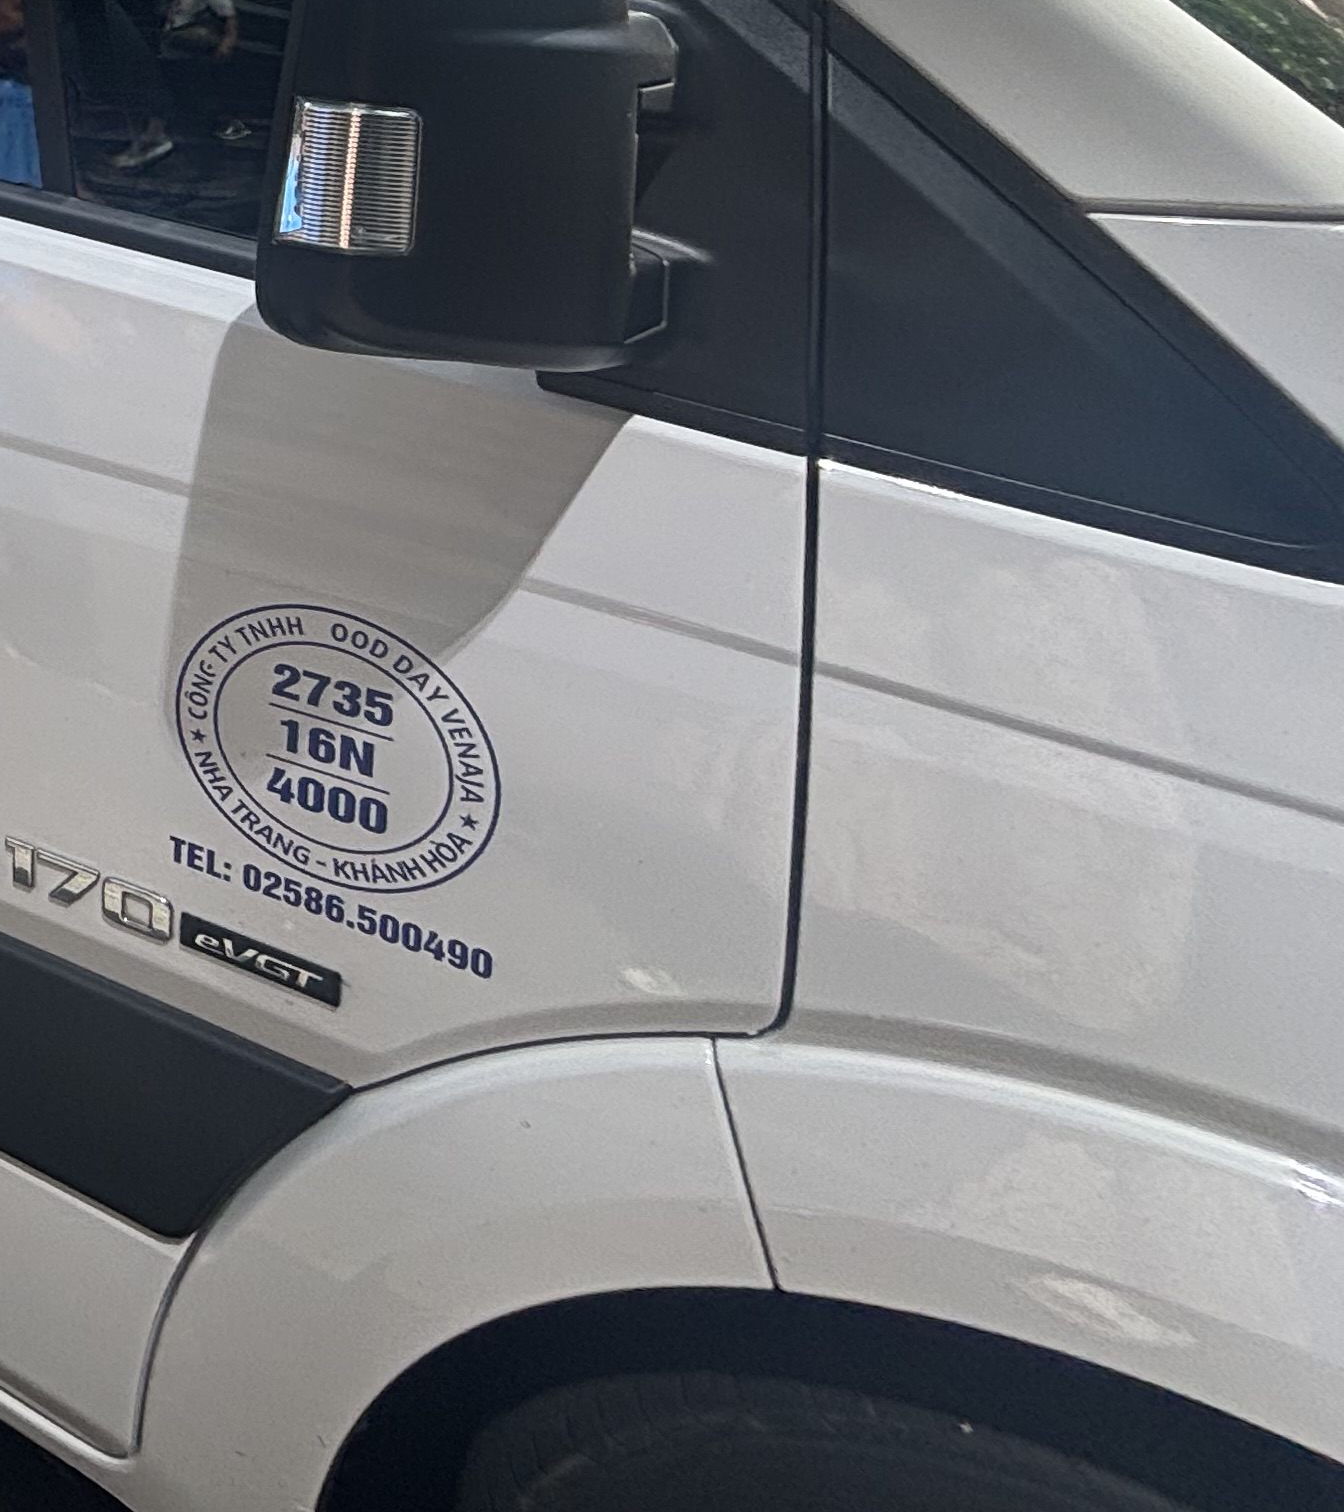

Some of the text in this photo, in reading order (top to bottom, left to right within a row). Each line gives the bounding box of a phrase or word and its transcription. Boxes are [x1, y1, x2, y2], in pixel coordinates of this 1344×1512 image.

[208, 635, 237, 664] TY
[234, 616, 306, 648] TNHH
[392, 654, 450, 703] DAY
[441, 708, 485, 805] VENAJA
[271, 663, 394, 727] 2735
[279, 719, 375, 777] 16N
[195, 750, 234, 802] NHA
[230, 799, 310, 866] TRANG
[333, 856, 428, 885] KHÁNH
[423, 831, 473, 874] HÒA
[266, 767, 389, 835] 4000
[5, 835, 175, 945] 170
[169, 835, 494, 980] TEL: 02586.500490
[194, 933, 324, 990] eVGT
